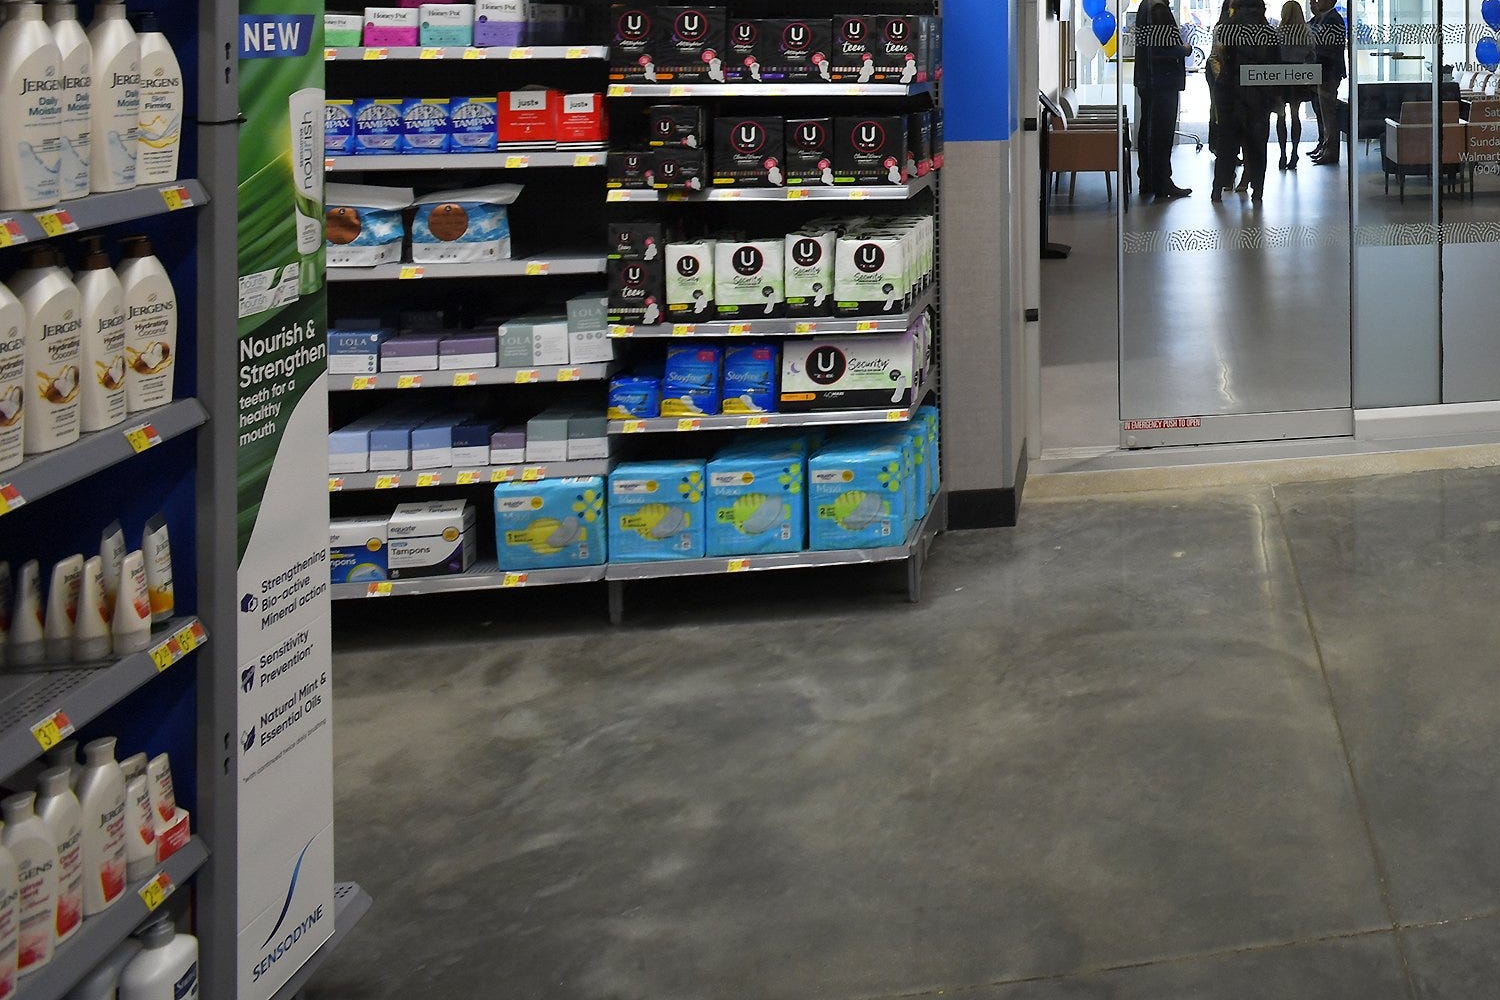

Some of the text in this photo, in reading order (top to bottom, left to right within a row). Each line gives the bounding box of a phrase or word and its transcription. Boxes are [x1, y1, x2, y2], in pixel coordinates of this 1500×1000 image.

[244, 22, 300, 52] NEW
[842, 41, 866, 53] teen
[885, 41, 908, 53] teen
[1247, 69, 1314, 81] Enter Here
[39, 97, 58, 106] Daily
[358, 118, 400, 130] TAMPAX
[404, 118, 447, 128] TAMPAX
[452, 117, 494, 128] TAMPAX
[304, 110, 312, 190] nourish
[1474, 164, 1499, 176] (904)
[621, 286, 645, 298] teen
[127, 300, 174, 320] JERGENS
[573, 308, 602, 318] LOLA
[135, 319, 169, 331] Hydrating
[138, 327, 167, 336] Coconut
[240, 319, 316, 362] Nourish &
[340, 338, 367, 346] LOLA
[501, 336, 531, 346] LOLA
[240, 342, 326, 388] Strengthen
[818, 352, 836, 372] U
[848, 358, 890, 370] Security
[240, 380, 295, 410] teeth for a
[240, 402, 281, 428] healthy
[1132, 421, 1162, 429] EMERGENCY
[1163, 419, 1177, 428] PUSH
[1179, 419, 1185, 427] TO
[1186, 419, 1200, 427] OPEN
[240, 421, 275, 446] mouth
[390, 525, 416, 535] equate
[392, 546, 430, 556] Tampons
[261, 548, 326, 594] Strengthening
[261, 574, 311, 612] Bio-active
[261, 581, 327, 630] Mineral action
[260, 629, 309, 669] Sensitivity
[260, 672, 327, 729] Natural Mint &
[260, 693, 321, 747] Essential Oils
[252, 903, 324, 984] SENSODYNE
